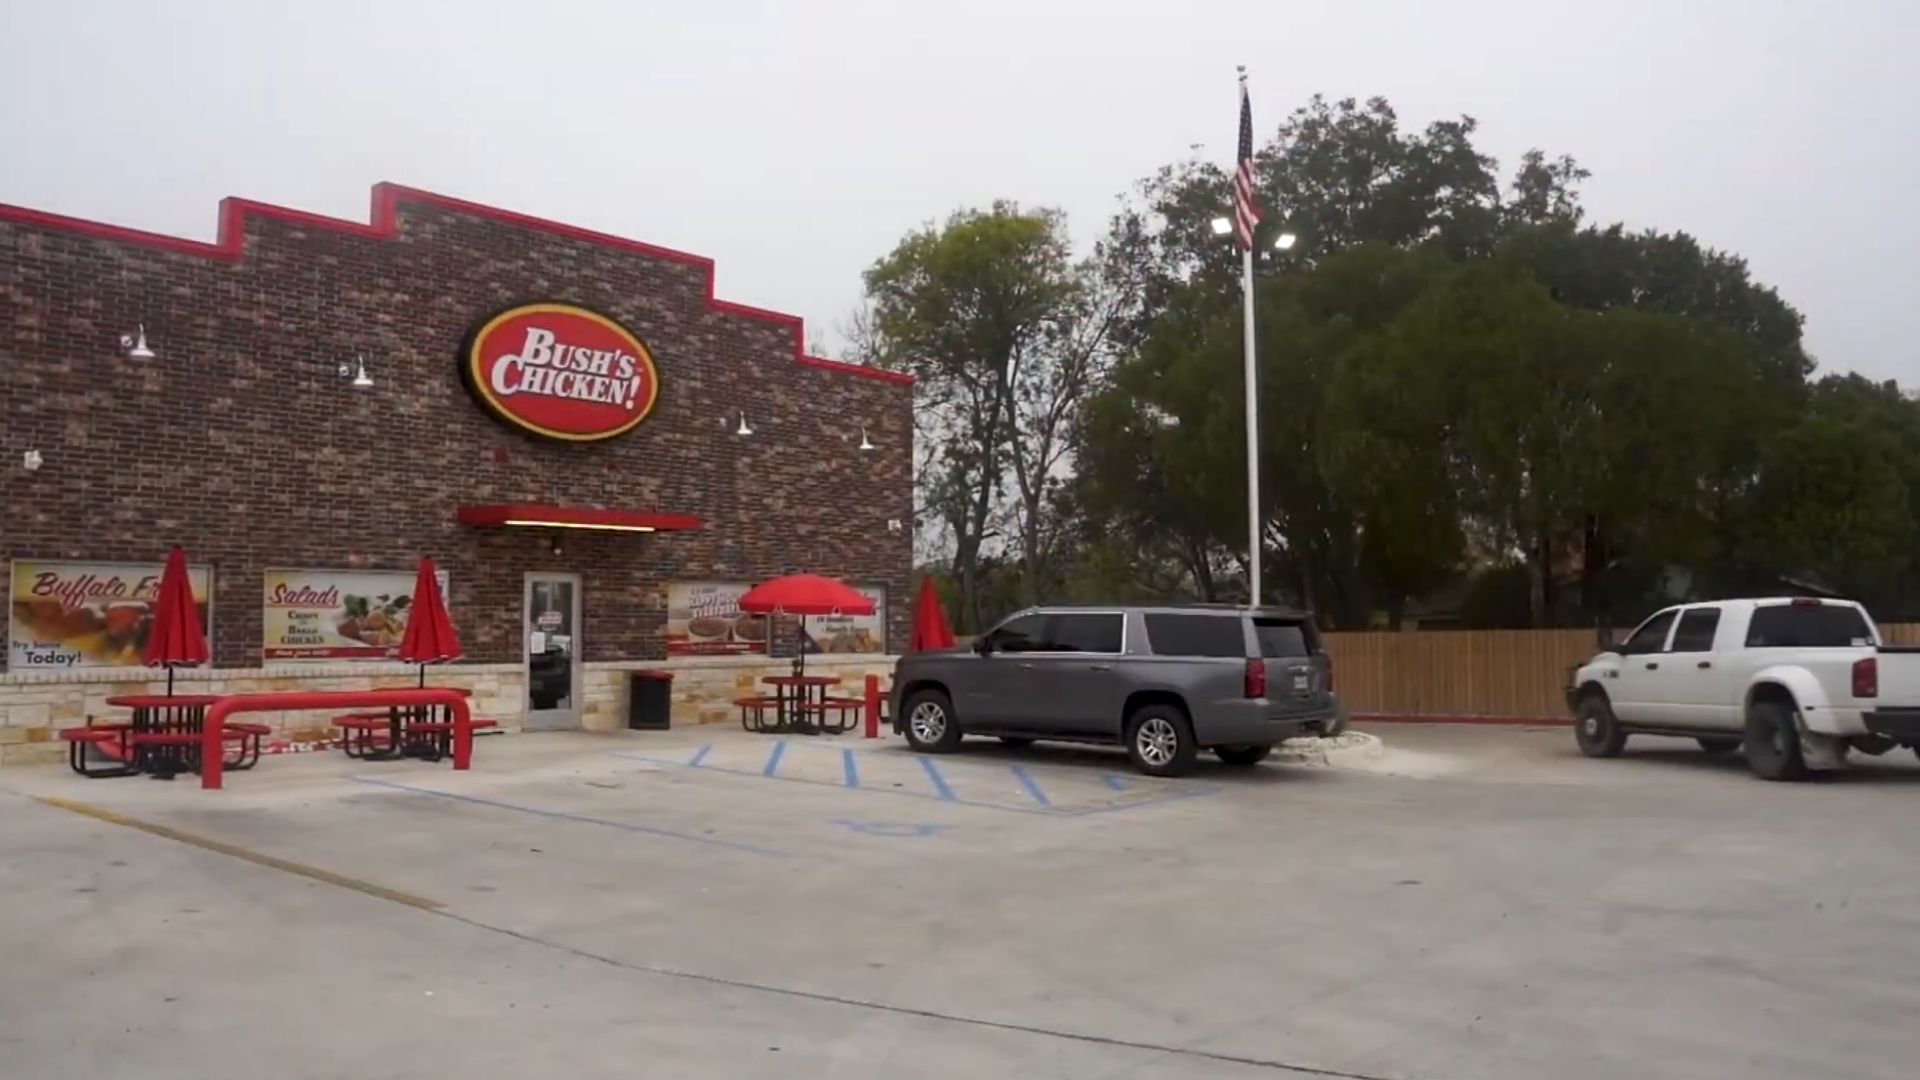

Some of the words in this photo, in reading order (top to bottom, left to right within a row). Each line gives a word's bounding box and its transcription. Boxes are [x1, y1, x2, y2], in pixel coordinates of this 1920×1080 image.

[521, 327, 636, 379] BUSH'S
[491, 354, 641, 410] CHICKEN!
[31, 572, 126, 609] Buffalo
[270, 583, 339, 606] Salads
[25, 650, 82, 667] Today!
